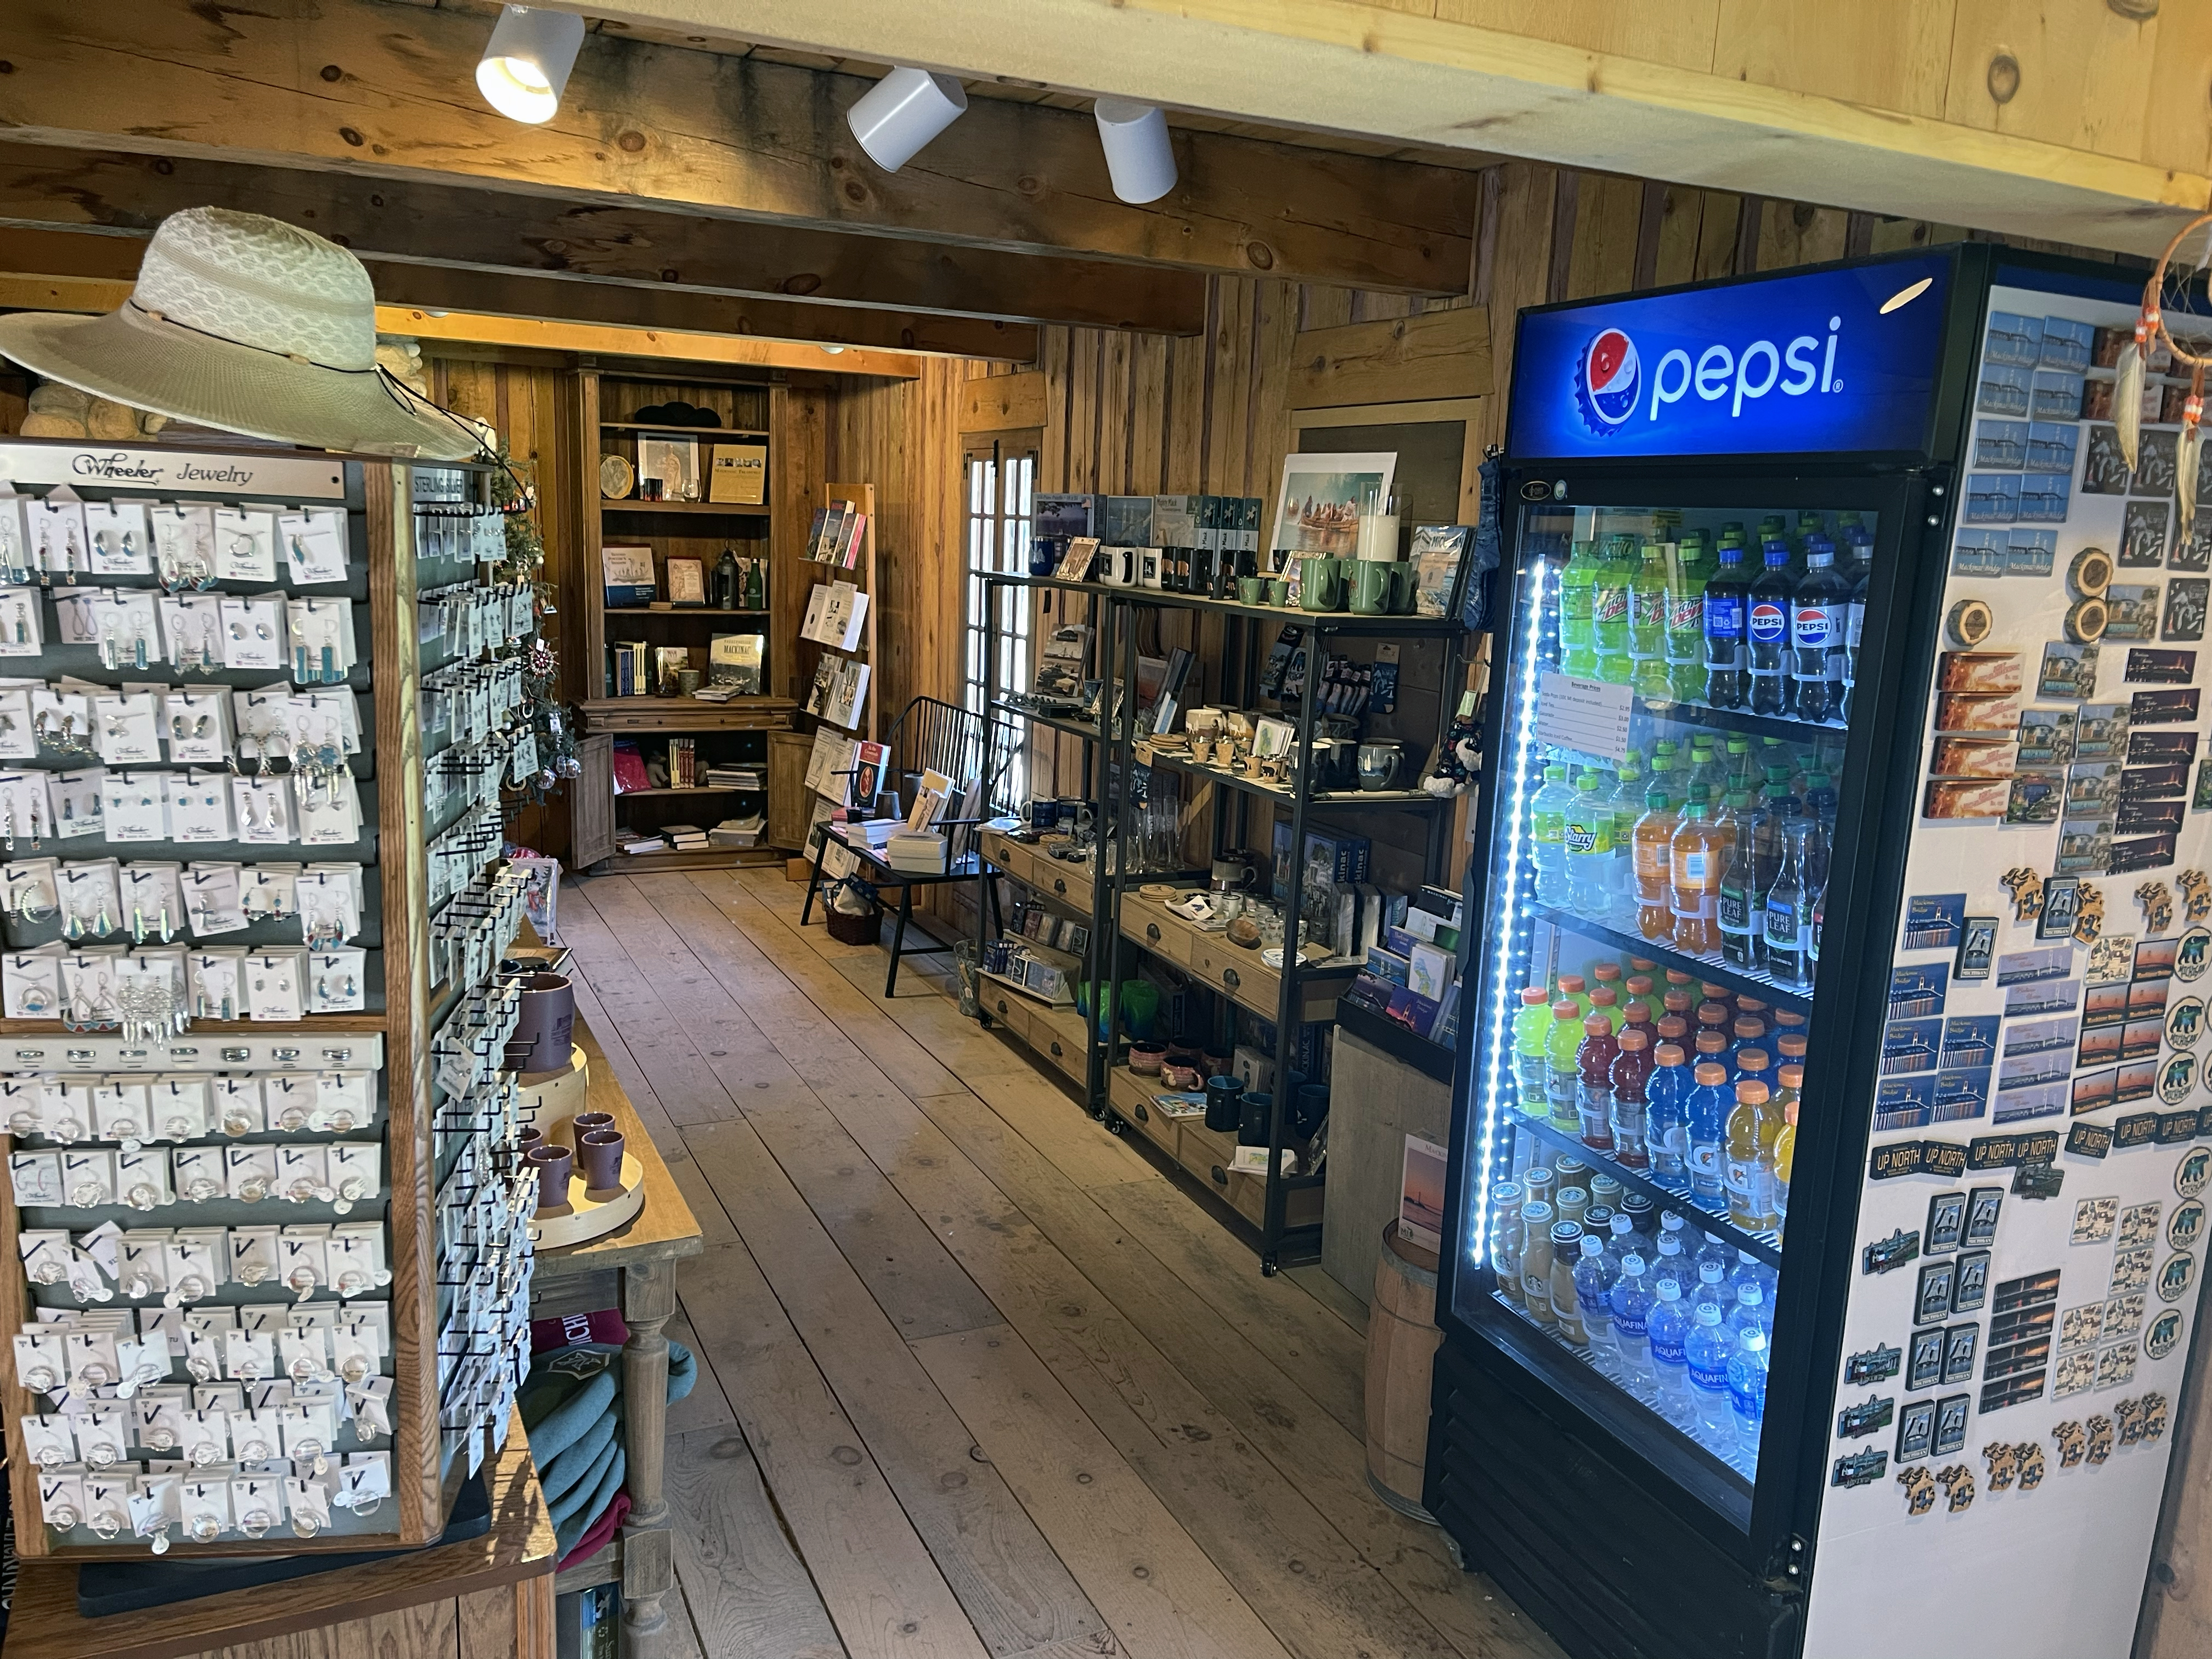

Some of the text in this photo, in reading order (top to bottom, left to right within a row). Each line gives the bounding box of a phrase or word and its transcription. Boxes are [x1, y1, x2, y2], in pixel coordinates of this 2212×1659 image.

[1650, 315, 1841, 421] pepsi
[72, 453, 253, 487] Wheeler Jewelry
[1752, 618, 1782, 626] PEPSI
[723, 645, 751, 655] MACKINAC
[1565, 825, 1596, 850] Starry
[1723, 897, 1742, 910] PURE
[1723, 906, 1743, 919] LEAF
[1769, 911, 1791, 926] PURE
[1769, 920, 1791, 934] LEAF
[2120, 1120, 2157, 1139] UP NORTH
[2162, 1118, 2197, 1136] UP NORTH
[2017, 1139, 2056, 1158] UP NORTH
[2074, 1130, 2111, 1150] UP NORTH
[1877, 1148, 1921, 1170] UP NORTH
[1926, 1148, 1967, 1169] UP NORTH
[1975, 1142, 2016, 1161] UP NORTH
[1728, 1163, 1748, 1189] G
